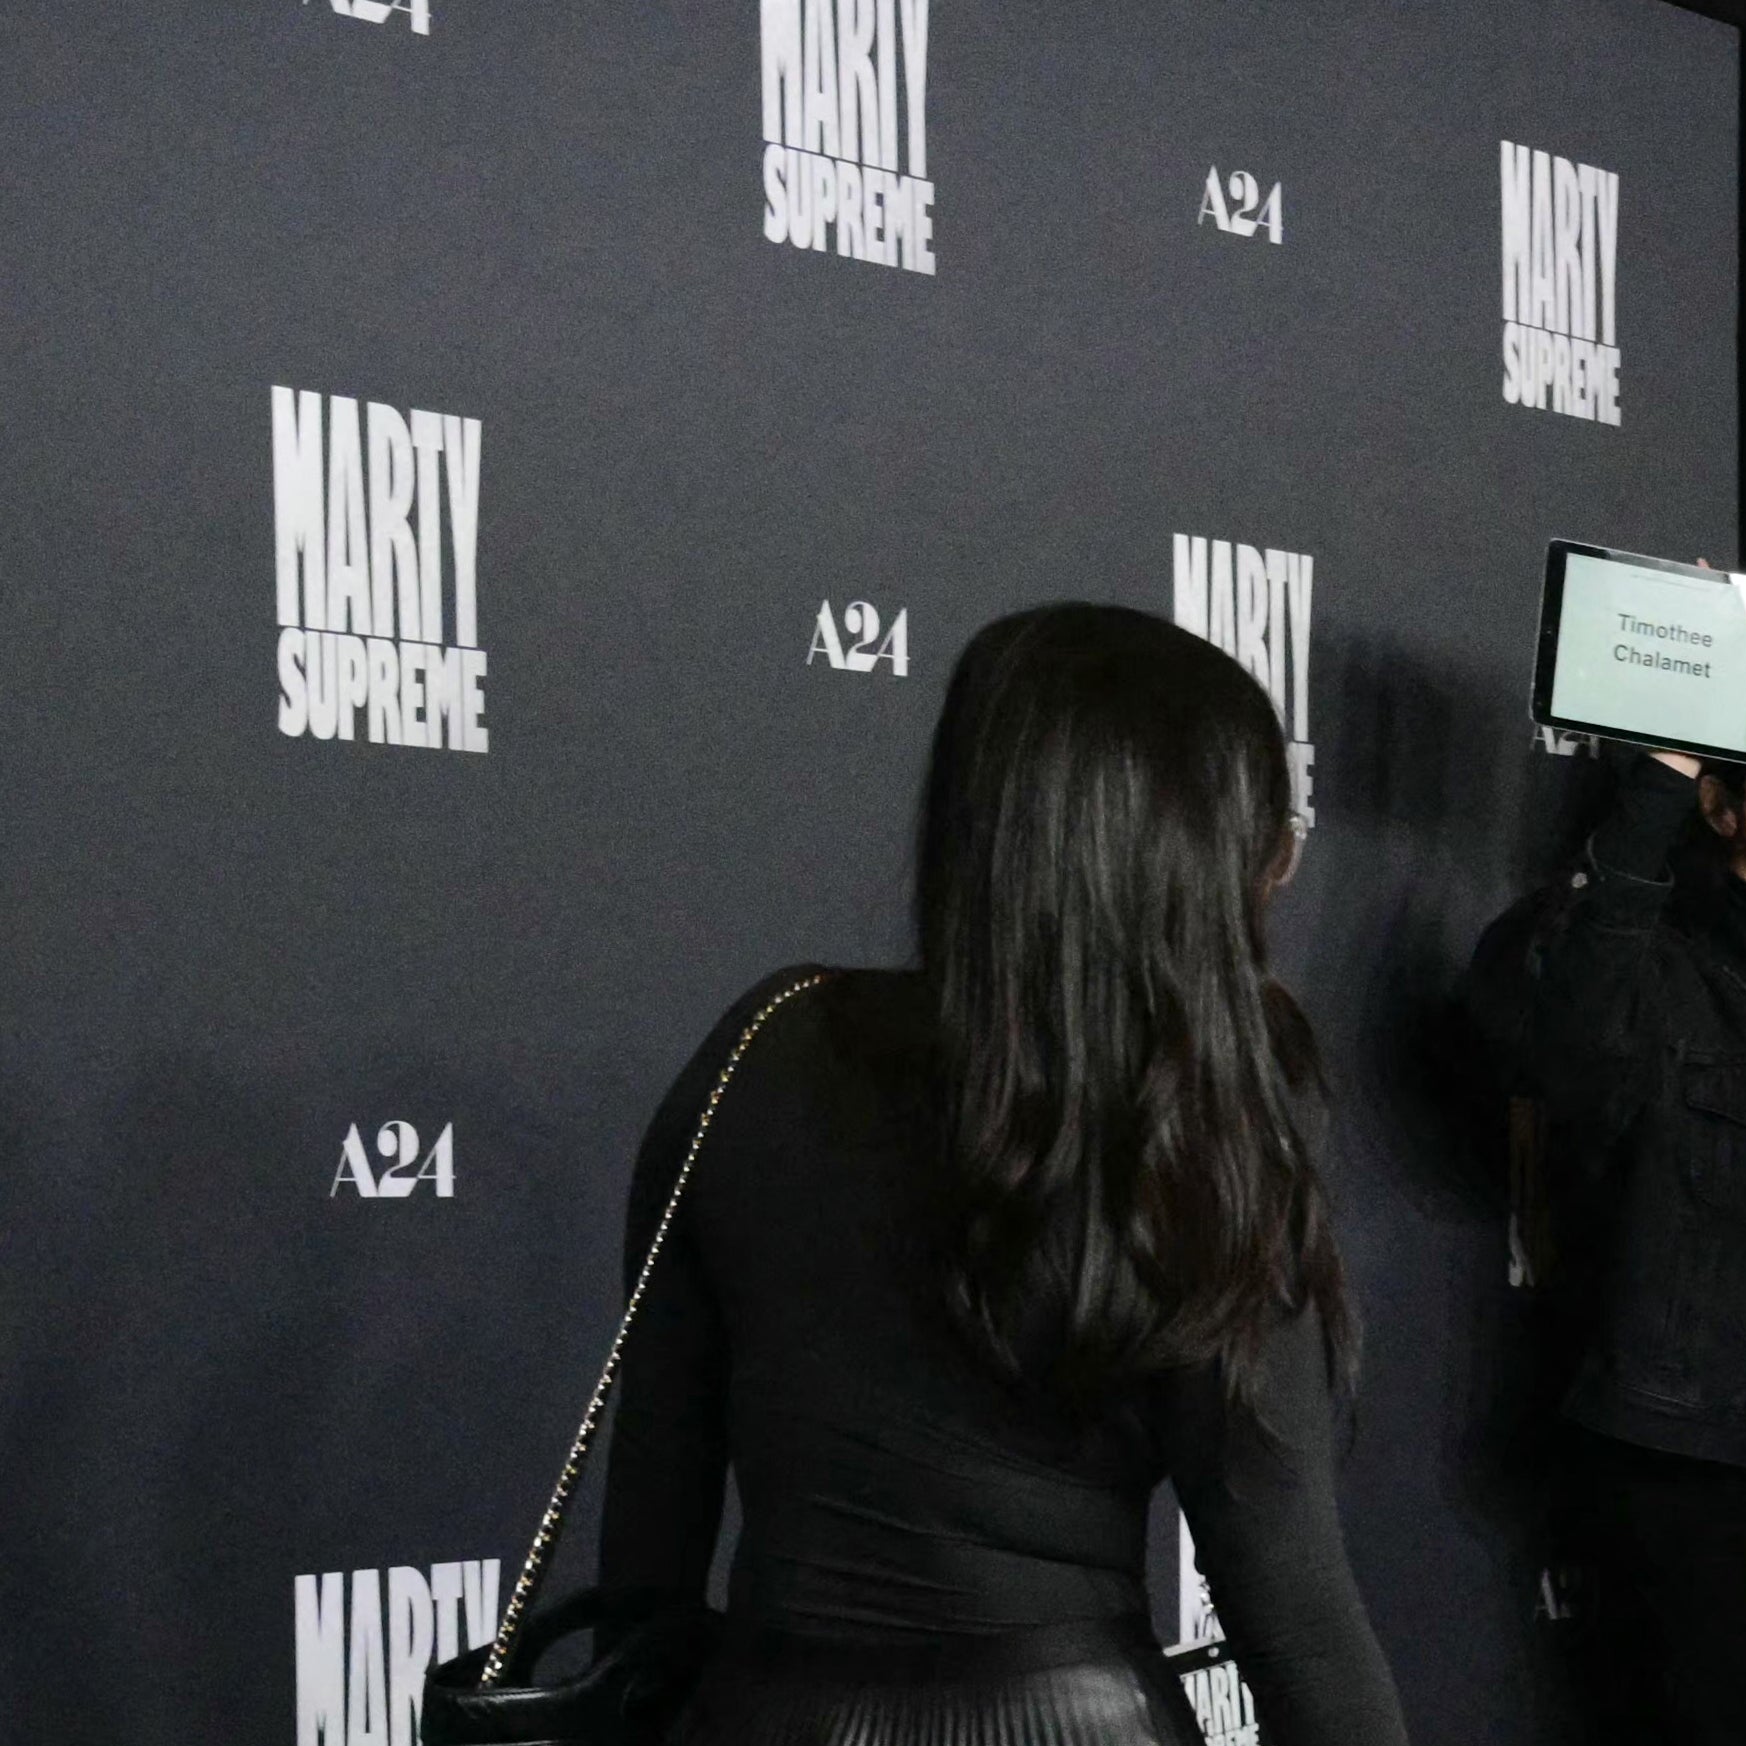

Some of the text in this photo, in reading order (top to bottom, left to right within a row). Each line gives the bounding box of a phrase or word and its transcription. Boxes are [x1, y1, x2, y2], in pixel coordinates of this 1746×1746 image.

[760, 0, 929, 179] MARTY
[763, 143, 936, 275] SUPREME
[1198, 165, 1283, 244] A24
[1500, 139, 1619, 347] MARTY
[1502, 321, 1622, 427] SUPREME
[271, 385, 482, 648] MARTY
[806, 600, 911, 678] A24
[1613, 644, 1711, 678] Chalamet
[1617, 612, 1713, 648] Timothee
[278, 627, 489, 753] SUPREME
[330, 1120, 456, 1198] A24
